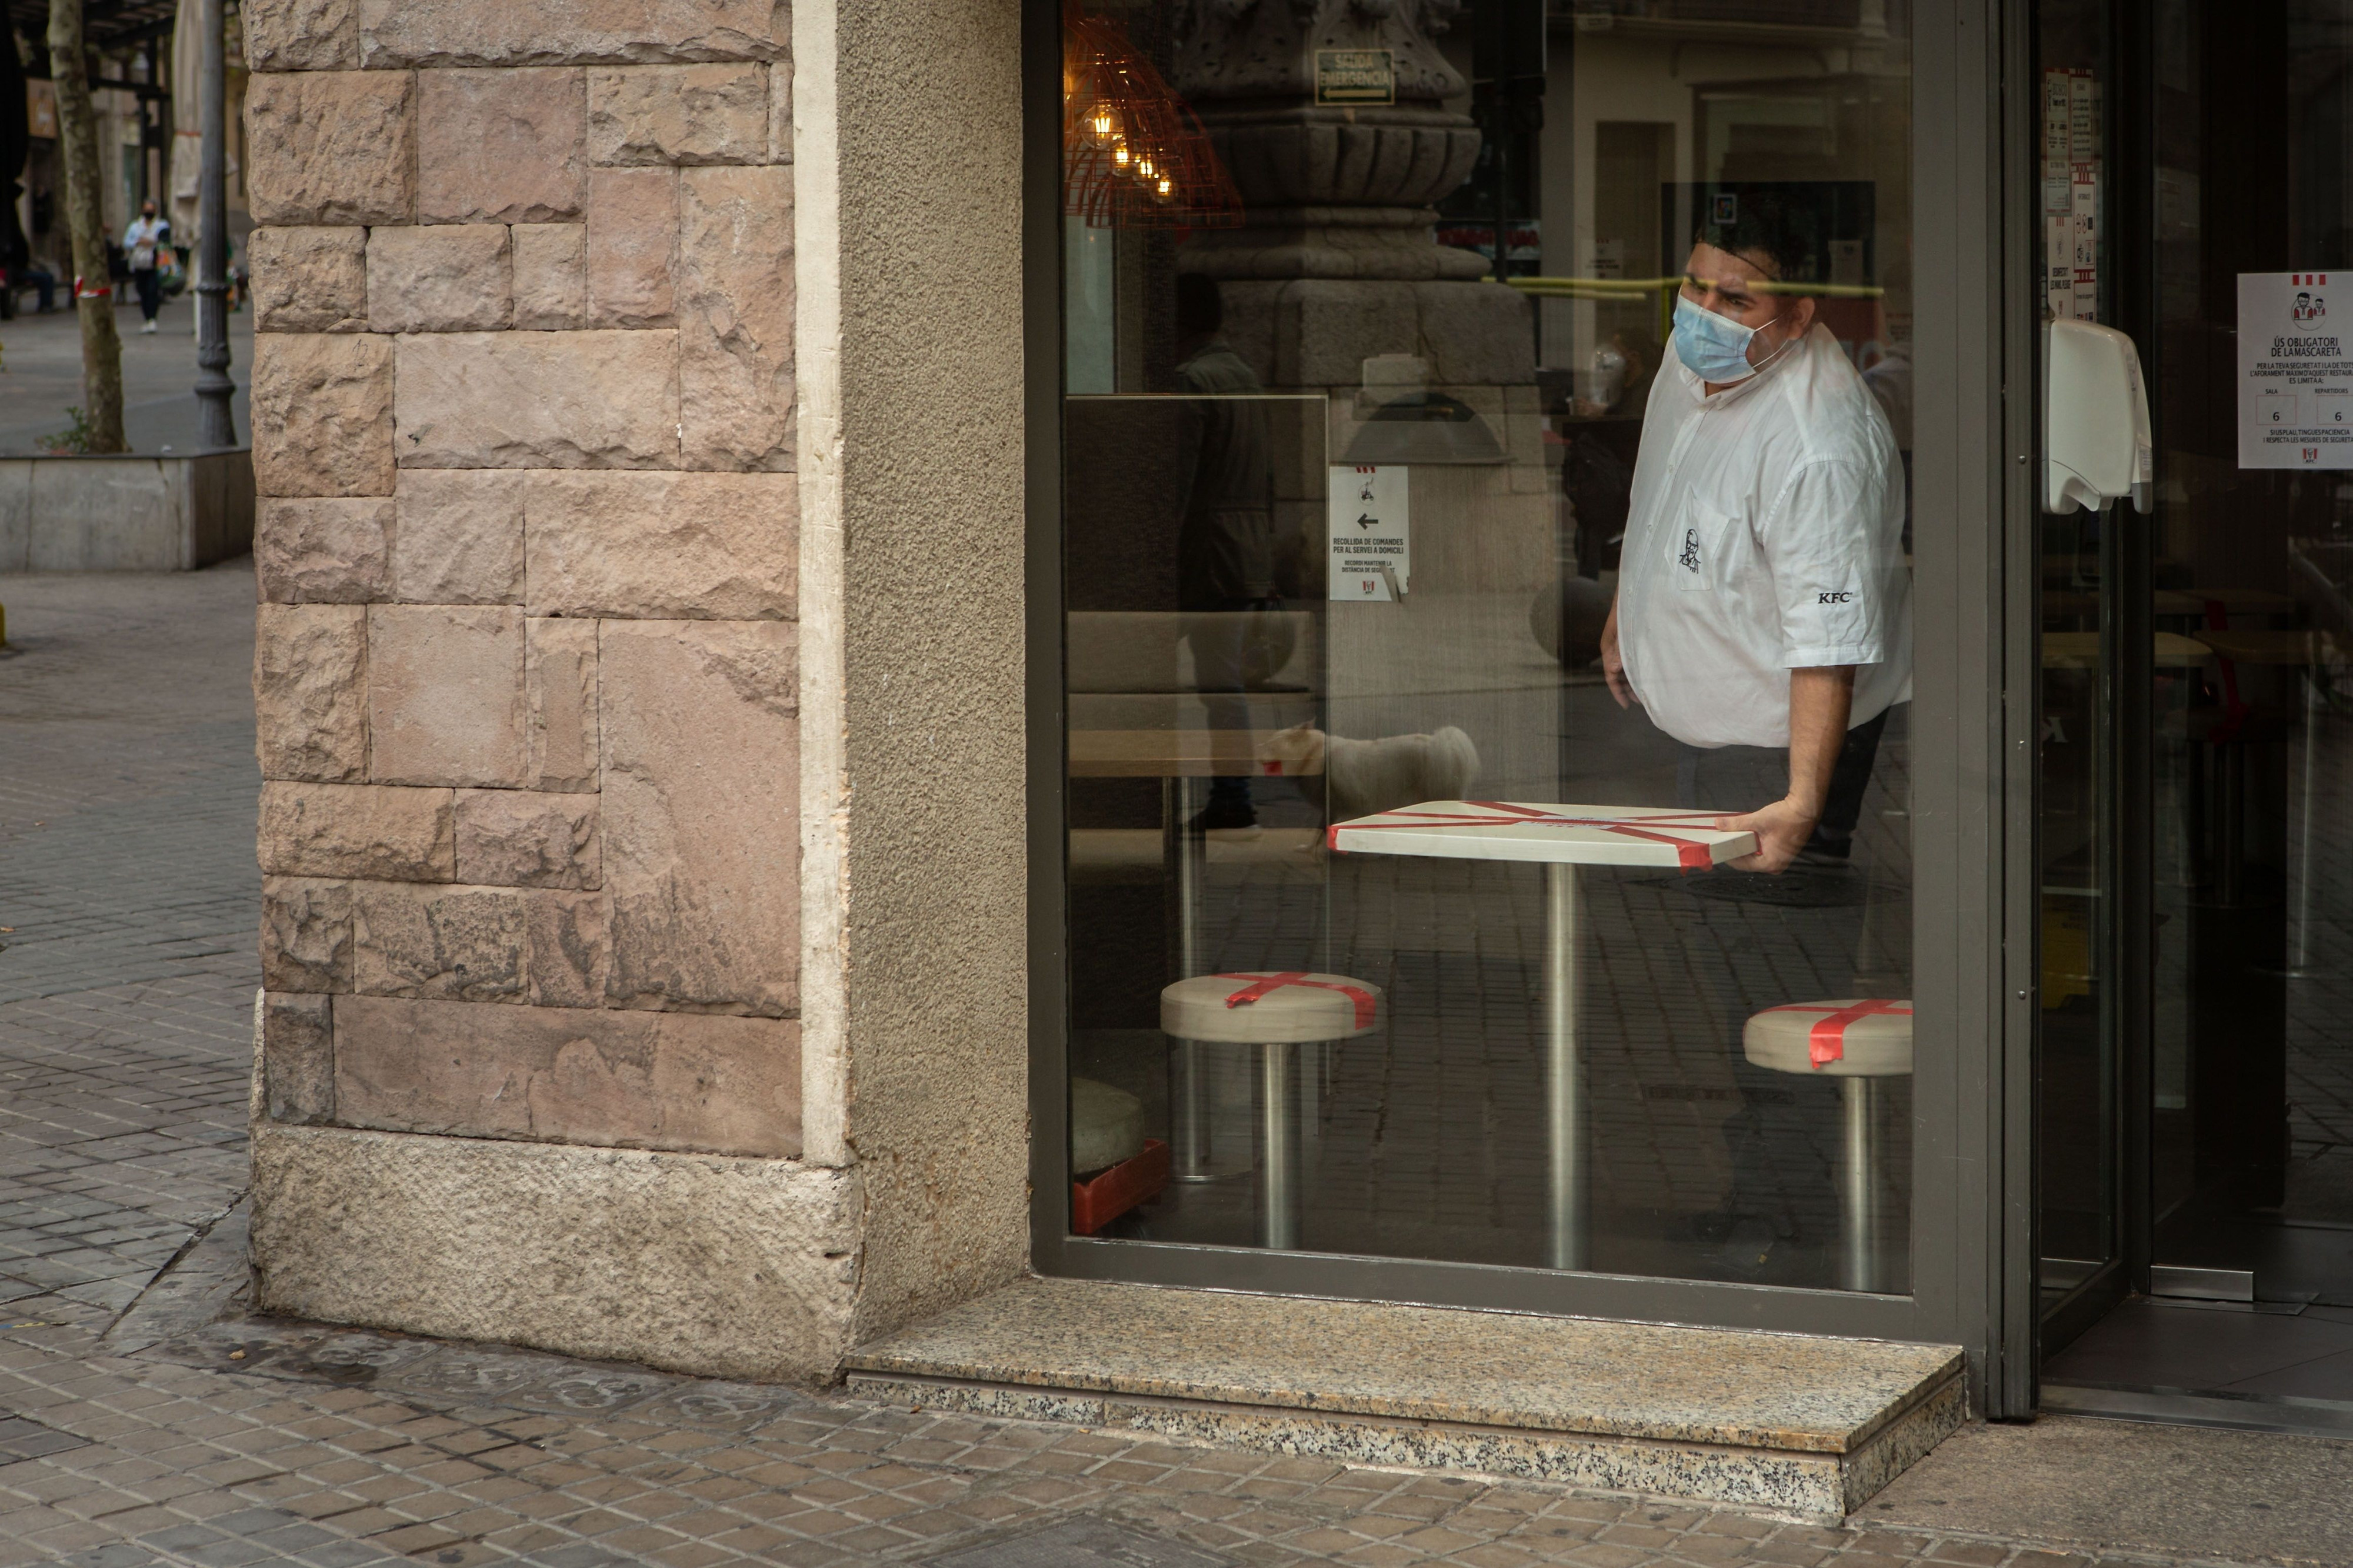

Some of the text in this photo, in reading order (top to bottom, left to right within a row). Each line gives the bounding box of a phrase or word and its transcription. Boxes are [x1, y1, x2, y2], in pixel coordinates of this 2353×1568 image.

[1320, 71, 1389, 85] EMERGENCIA
[2274, 335, 2338, 347] ÚS OBLIGATORI
[2271, 348, 2281, 357] DE
[2273, 412, 2342, 421] 6 6
[1818, 592, 1851, 603] KFC
